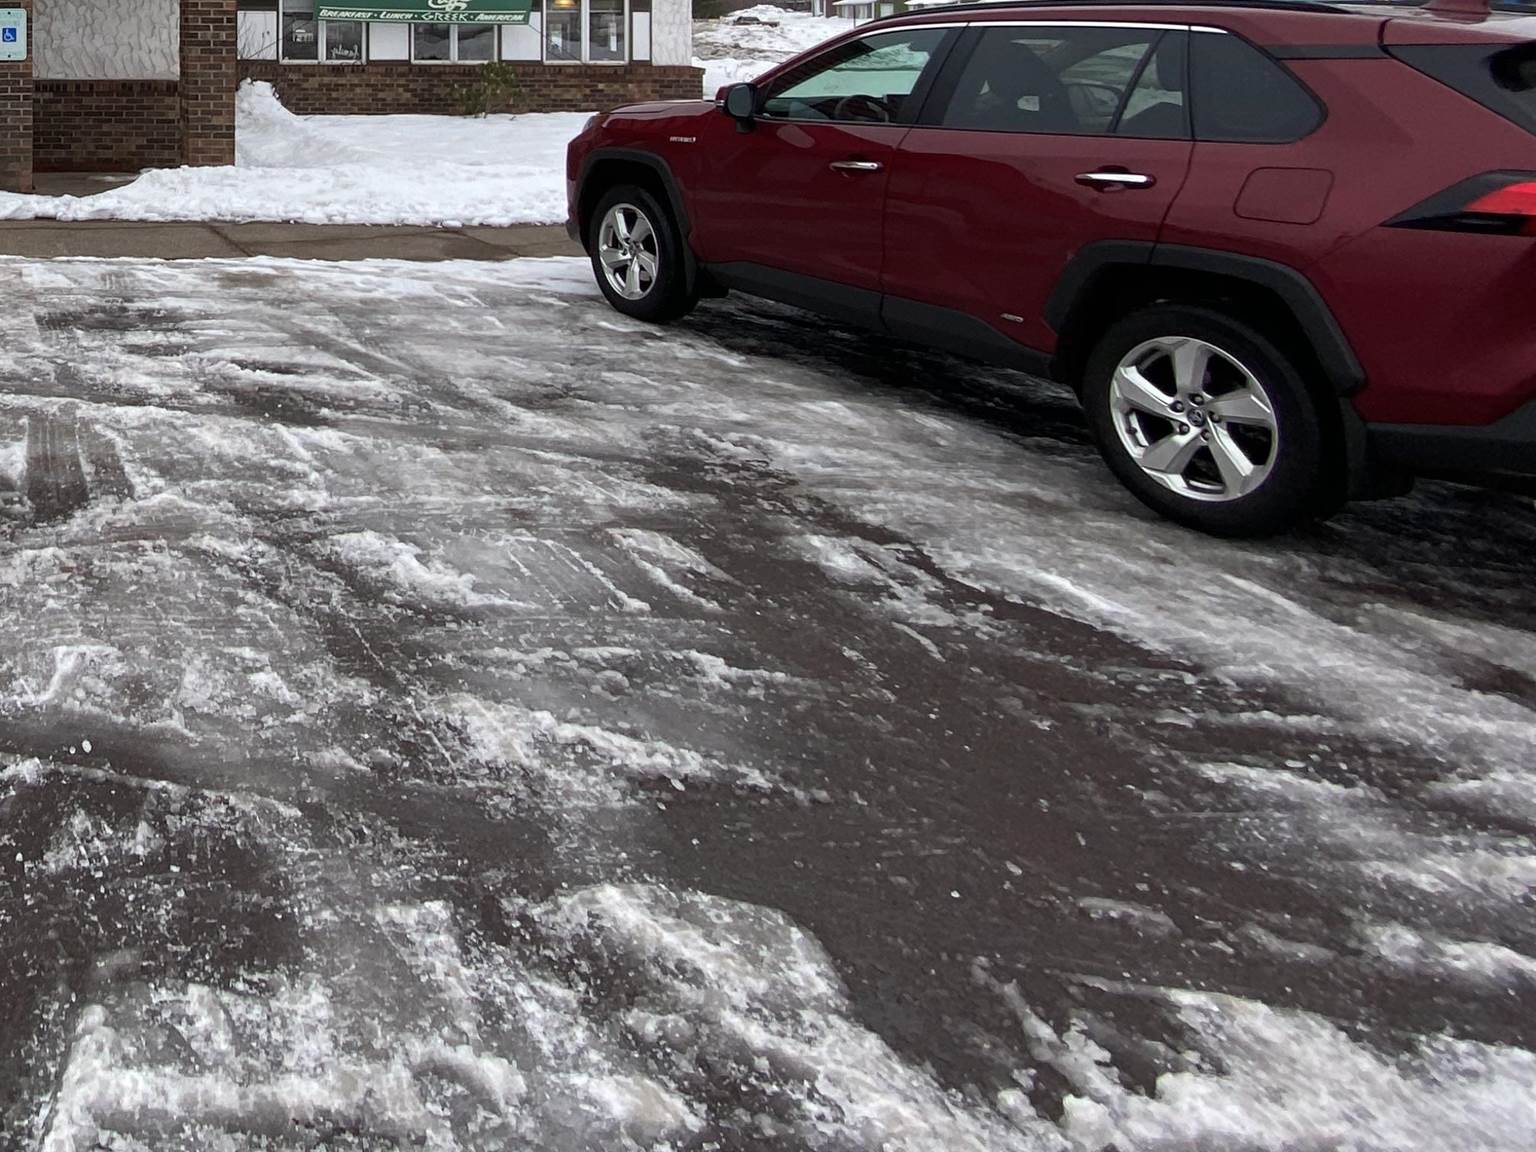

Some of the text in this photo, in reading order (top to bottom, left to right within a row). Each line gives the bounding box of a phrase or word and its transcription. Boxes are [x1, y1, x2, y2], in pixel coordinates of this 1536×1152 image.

[319, 9, 524, 22] BREAKFAST LUNCH GREEK AMERICAN
